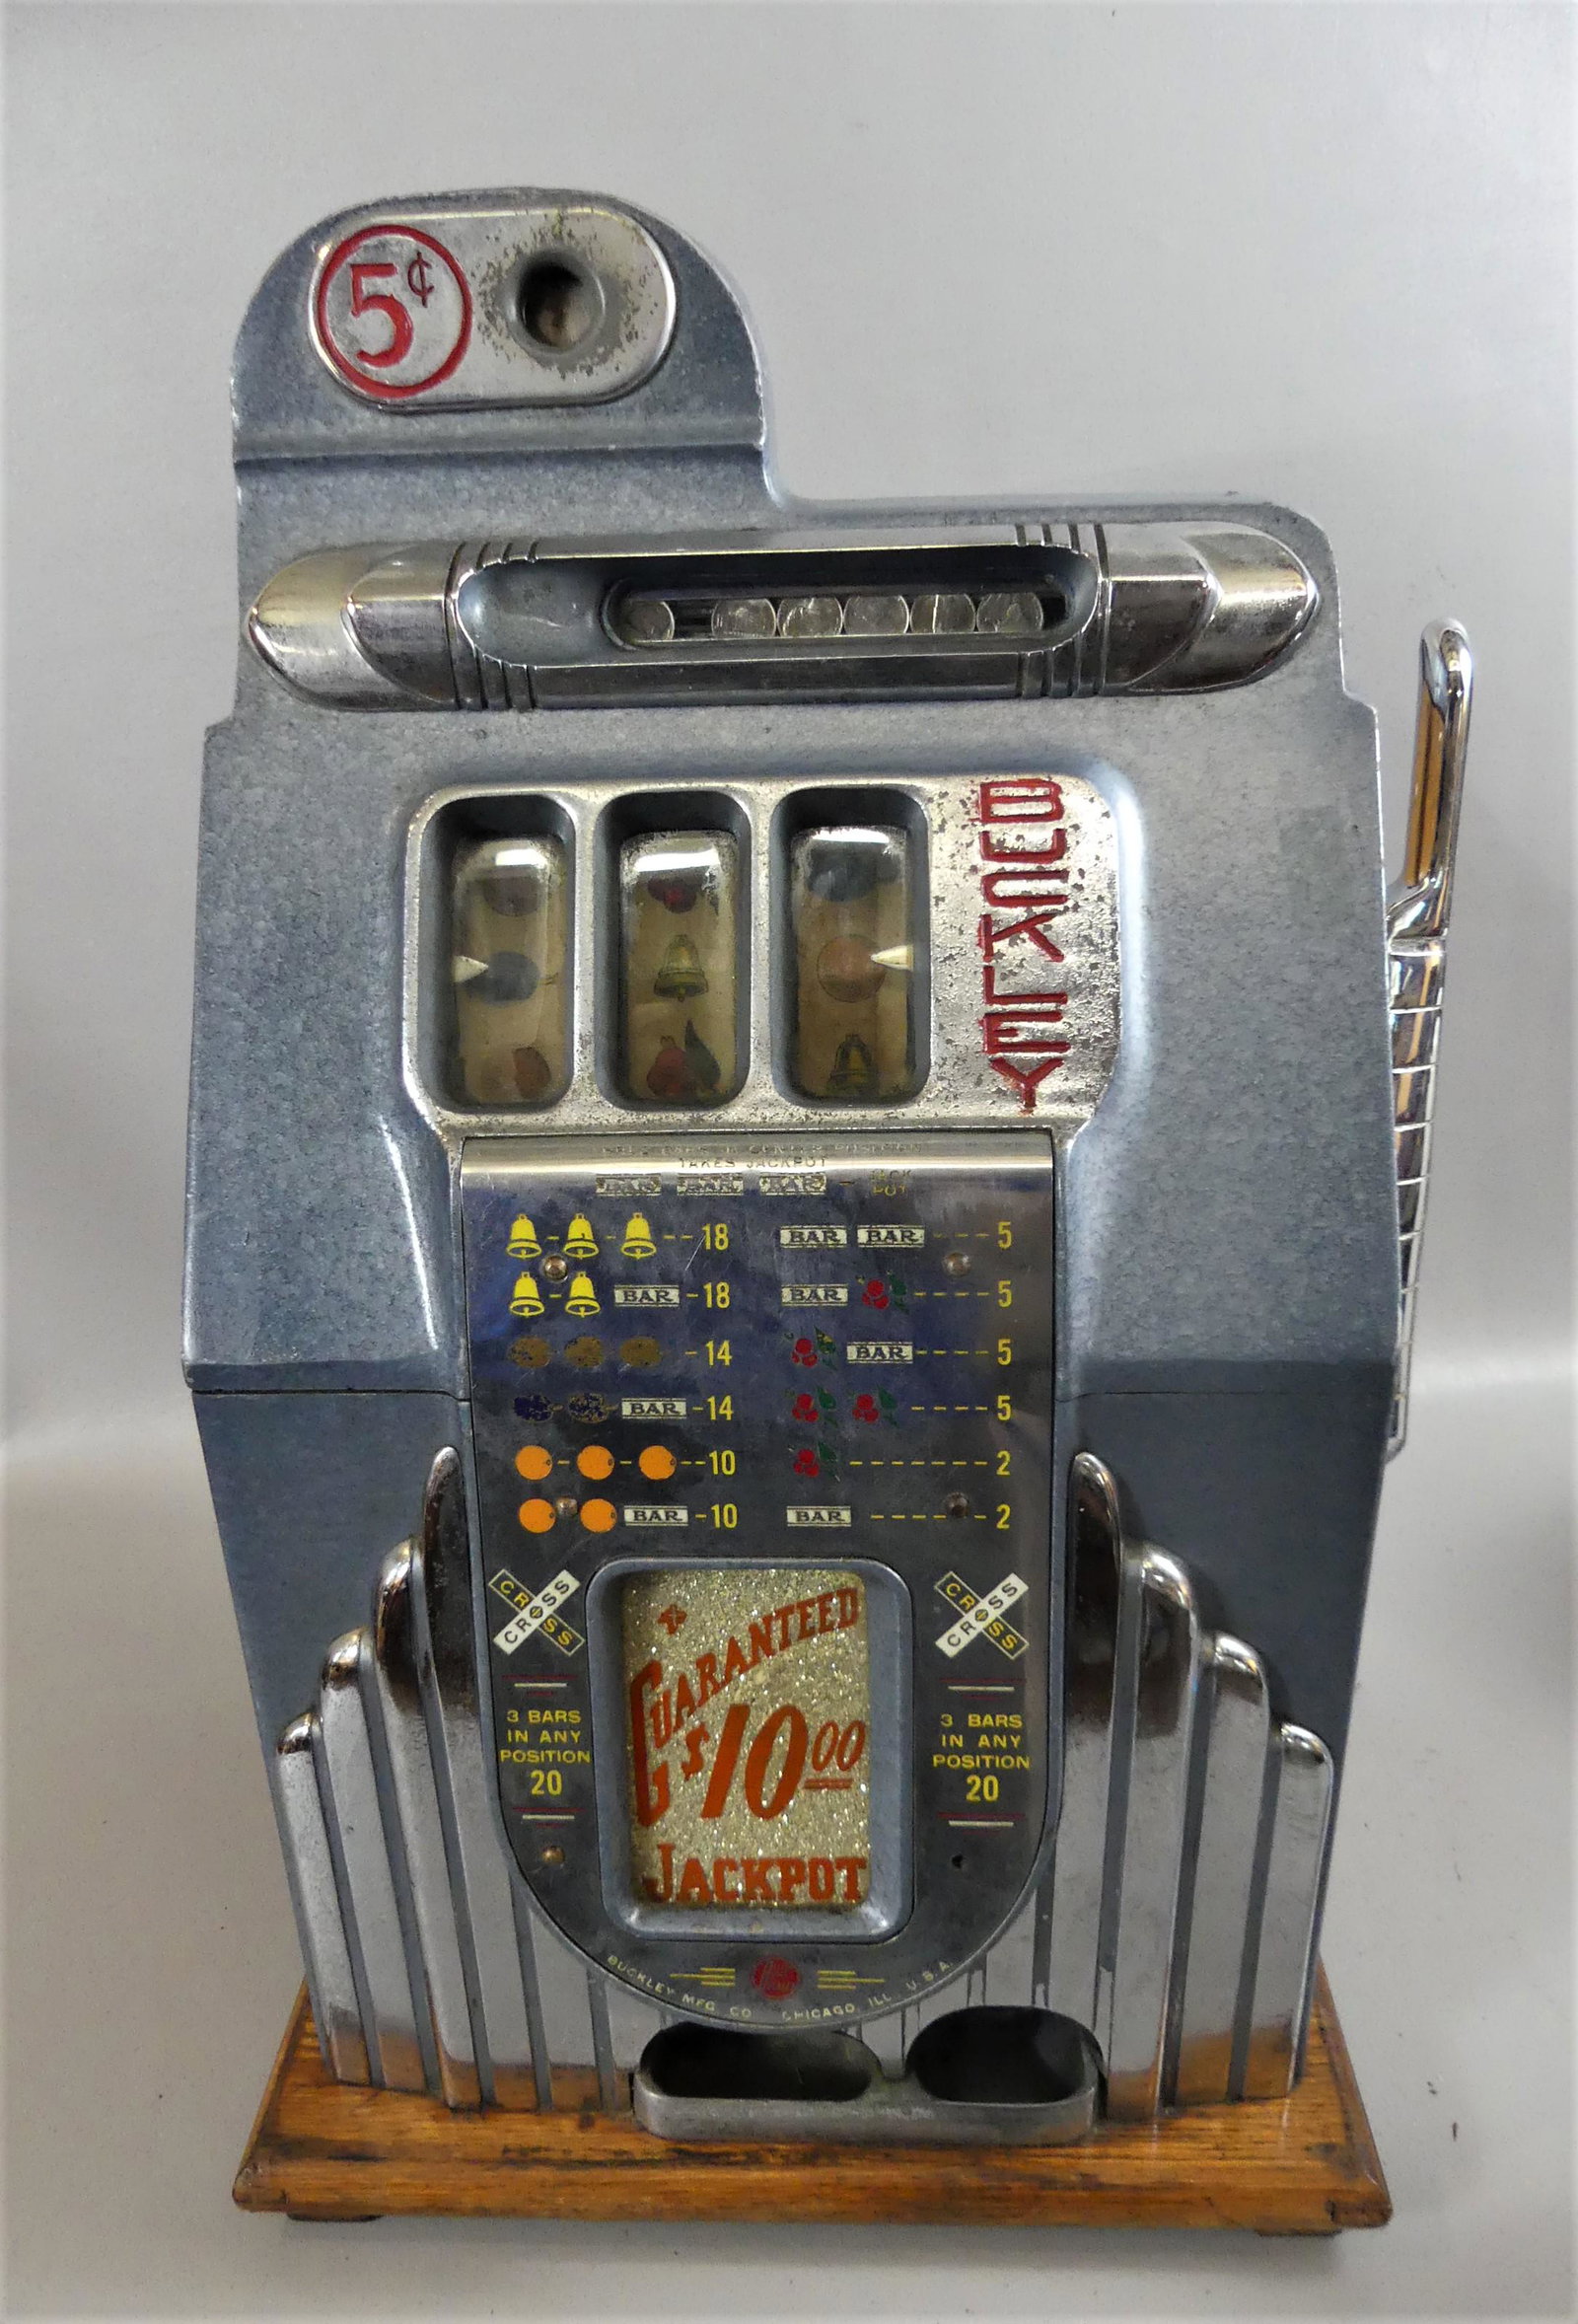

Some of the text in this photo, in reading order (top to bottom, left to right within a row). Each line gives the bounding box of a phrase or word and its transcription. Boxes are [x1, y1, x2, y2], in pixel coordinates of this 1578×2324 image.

[350, 250, 435, 368] 5¢
[974, 777, 1071, 1115] BUCKLEY
[747, 1155, 829, 1168] JACKPOT
[702, 1223, 730, 1251] 18
[788, 1228, 841, 1246] BAR
[864, 1228, 919, 1246] BAR
[997, 1221, 1013, 1249] 5
[622, 1288, 675, 1304] BAR
[703, 1281, 731, 1309] 18
[790, 1286, 843, 1303] BAR
[997, 1280, 1013, 1308] 5
[705, 1340, 733, 1366] 14
[854, 1344, 908, 1361] BAR
[997, 1339, 1013, 1365] 5
[629, 1402, 681, 1416] BAR
[707, 1395, 734, 1421] 14
[997, 1395, 1012, 1421] 5
[708, 1450, 736, 1476] 10
[996, 1450, 1011, 1476] 2
[632, 1508, 683, 1523] BAR
[710, 1503, 738, 1529] 10
[794, 1509, 845, 1524] BAR
[996, 1504, 1011, 1529] 2
[504, 1579, 571, 1644] CROSS
[947, 1582, 1018, 1647] CROSS
[507, 1709, 582, 1724] 3 BARS
[630, 1586, 859, 1827] GUARANTEED
[940, 1713, 1023, 1728] 3 BARS
[507, 1729, 582, 1744] IN ANY
[941, 1734, 1022, 1748] IN ANY
[499, 1749, 591, 1764] POSITION
[932, 1754, 1032, 1770] POSITION
[530, 1769, 563, 1796] 20
[966, 1775, 1000, 1802] 20
[641, 1842, 867, 1904] JACKPOT
[607, 1954, 676, 1996] BUCKLEY
